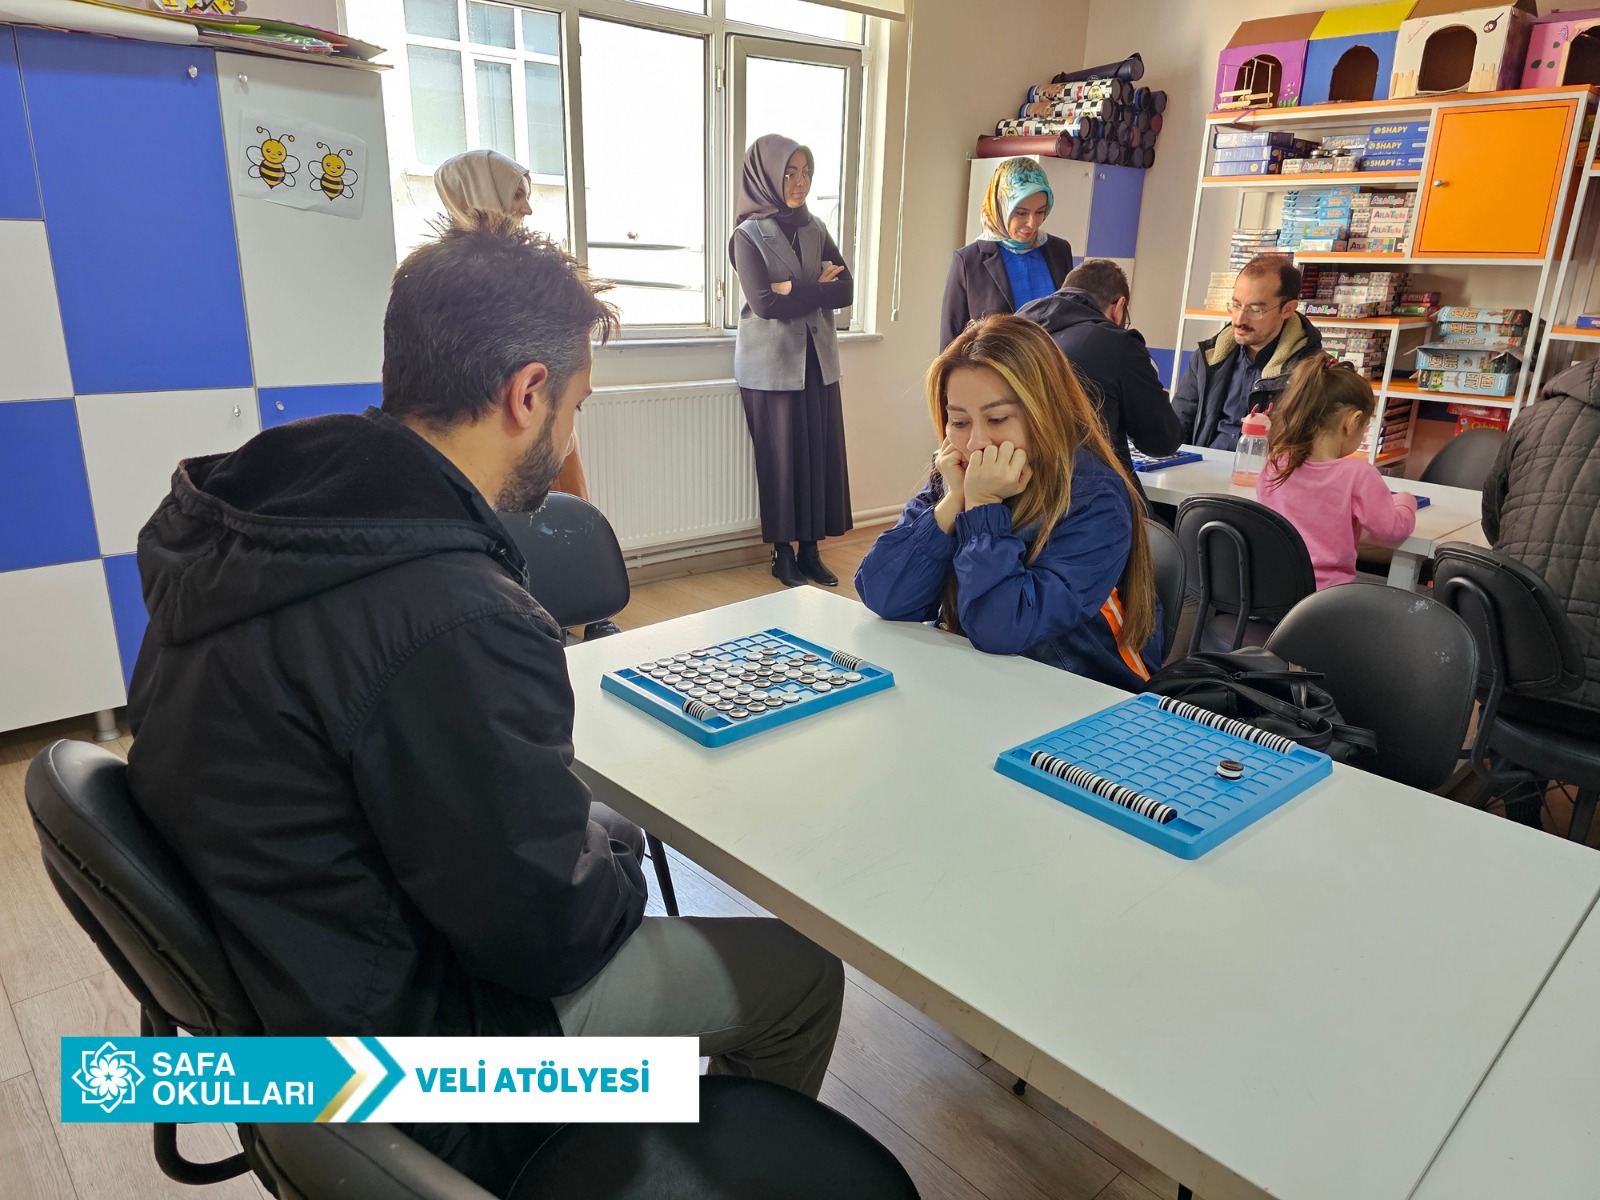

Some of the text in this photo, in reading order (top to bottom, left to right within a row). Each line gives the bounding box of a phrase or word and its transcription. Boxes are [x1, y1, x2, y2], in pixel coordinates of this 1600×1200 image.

[1381, 126, 1408, 134] SHAPY
[1370, 159, 1395, 167] SHAPY
[1464, 371, 1480, 390] CITY
[1480, 373, 1496, 389] RED
